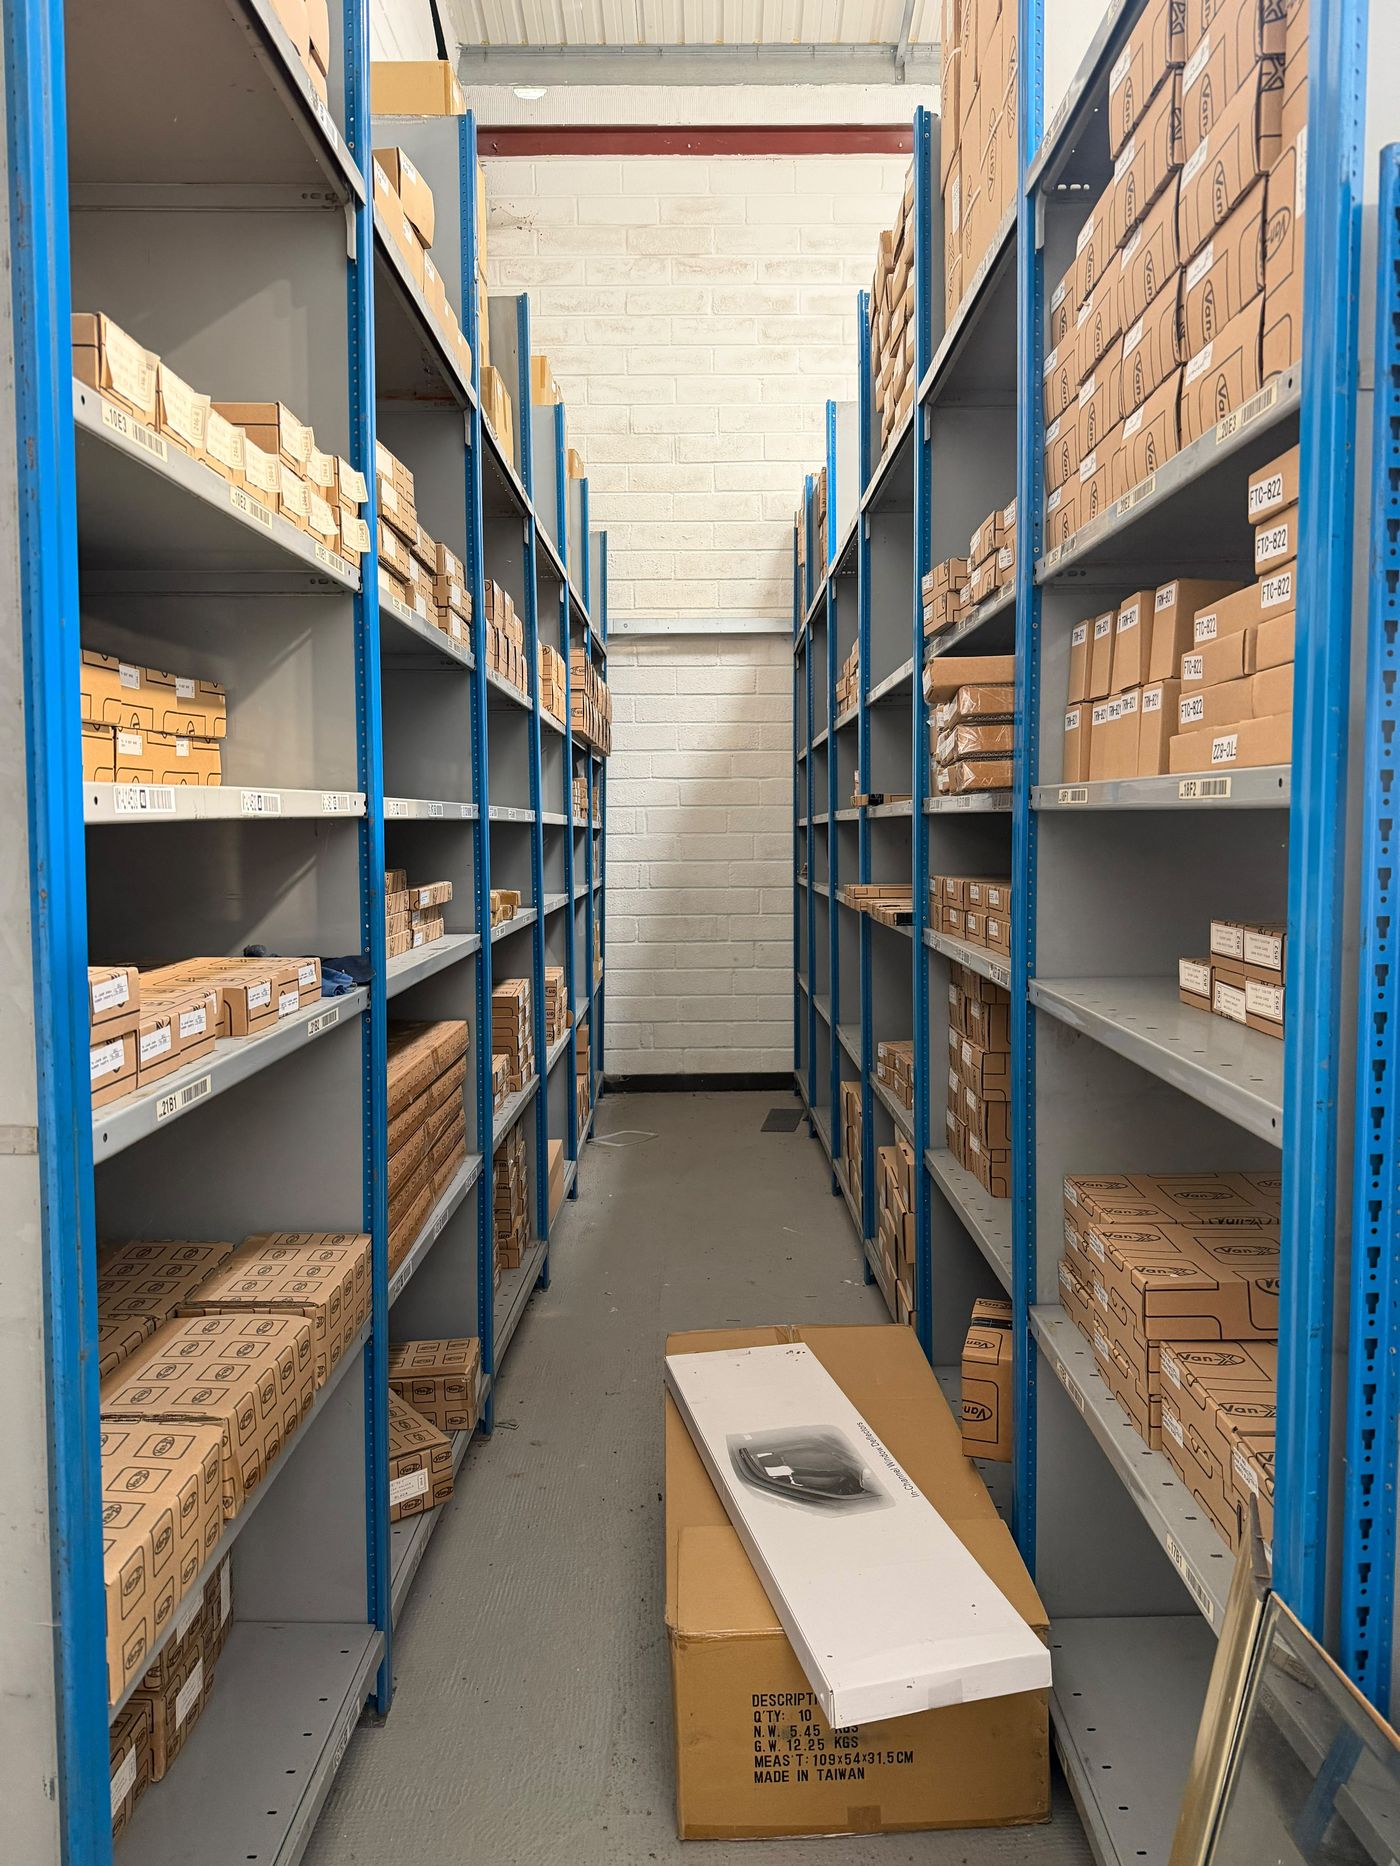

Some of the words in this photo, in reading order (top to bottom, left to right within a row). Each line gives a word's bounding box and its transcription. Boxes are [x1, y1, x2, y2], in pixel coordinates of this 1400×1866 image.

[1250, 478, 1281, 508] FTC-822
[1257, 528, 1286, 556] FTC-822
[1262, 576, 1290, 601] FTC-822
[1195, 617, 1216, 636] FTC-822
[1184, 658, 1202, 675] FTC-822
[1180, 699, 1203, 719] FTC-822
[1178, 1352, 1238, 1366] Van-X
[877, 1446, 896, 1469] Window
[753, 1710, 785, 1723] Q'TY:
[798, 1709, 812, 1722] 10
[753, 1725, 781, 1738] N.W.
[790, 1724, 821, 1738] 5.45
[754, 1739, 781, 1752] G.W.
[786, 1738, 825, 1751] 12.25
[834, 1736, 859, 1749] KGS
[754, 1770, 790, 1783] MADE
[797, 1769, 809, 1782] IN
[816, 1767, 865, 1781] TAIWAN
